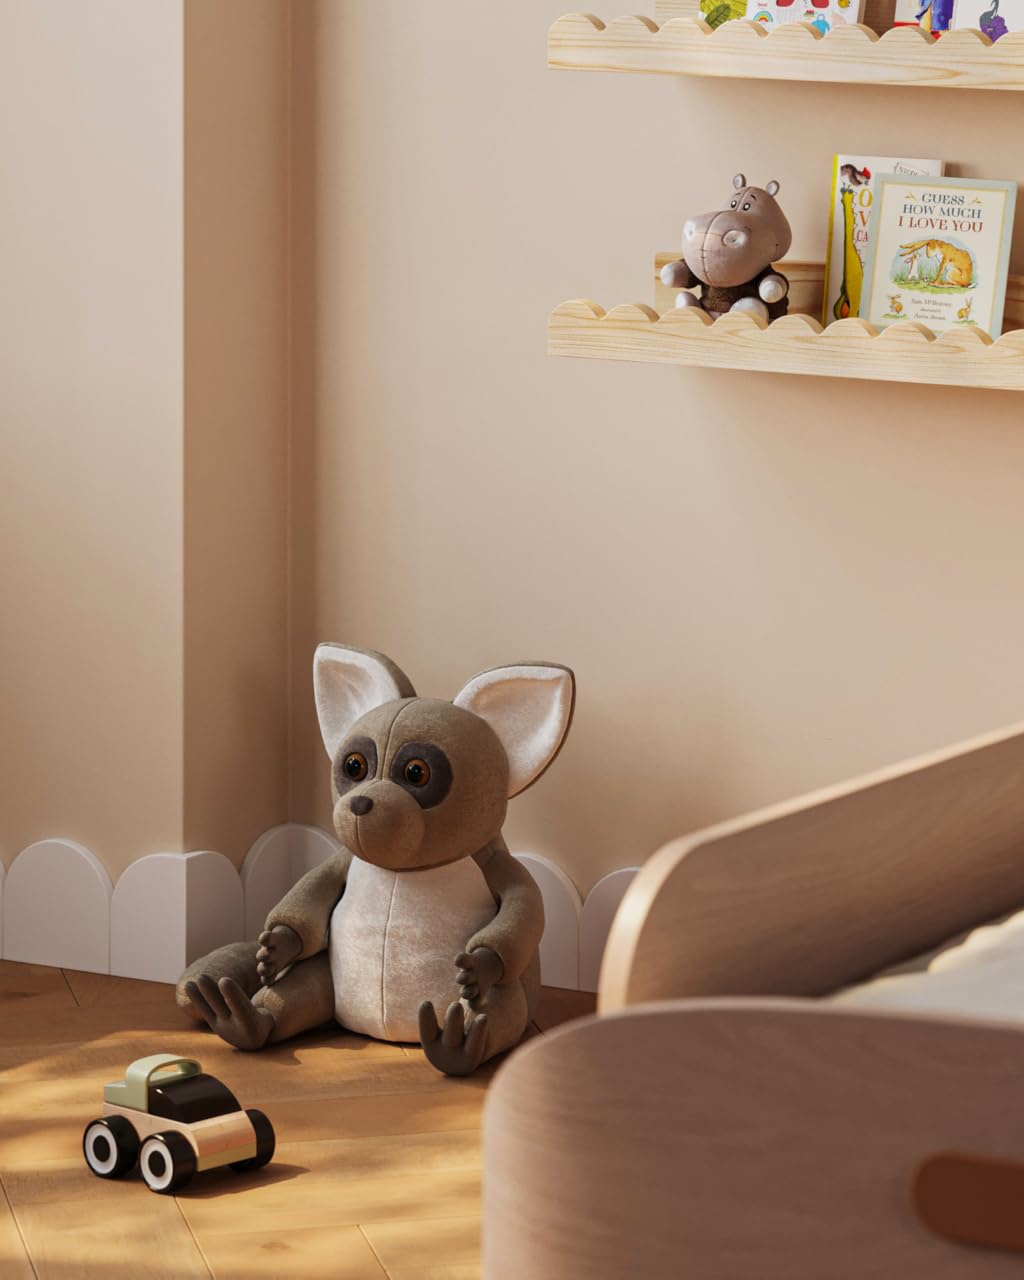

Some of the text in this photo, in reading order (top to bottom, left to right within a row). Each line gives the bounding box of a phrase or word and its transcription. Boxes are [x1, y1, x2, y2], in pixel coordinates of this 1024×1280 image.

[921, 192, 966, 206] GUESS
[903, 203, 983, 219] HOW MUCH
[898, 215, 984, 233] I LOVE YOU
